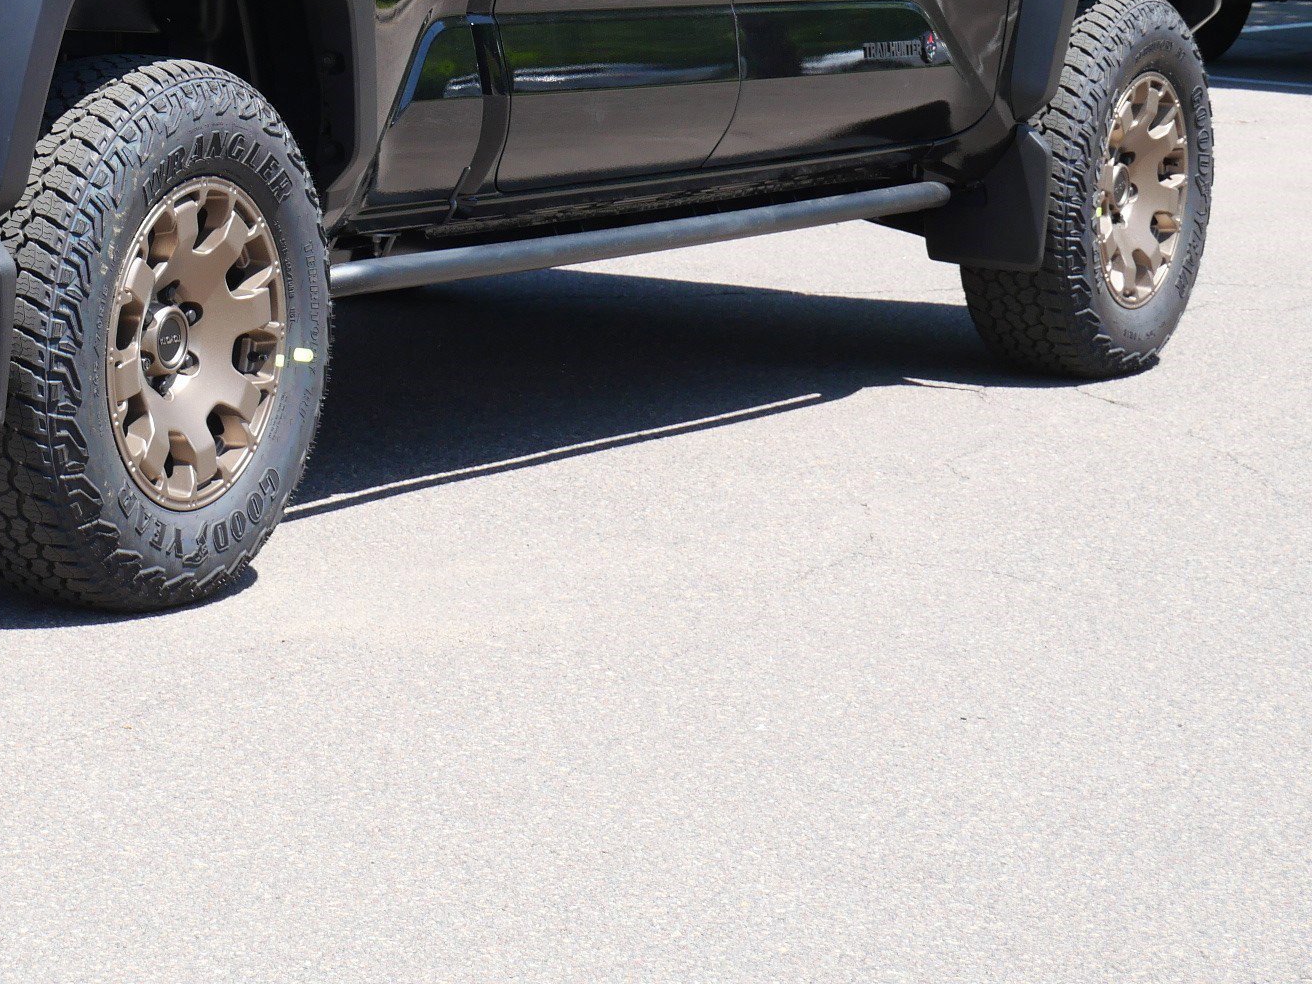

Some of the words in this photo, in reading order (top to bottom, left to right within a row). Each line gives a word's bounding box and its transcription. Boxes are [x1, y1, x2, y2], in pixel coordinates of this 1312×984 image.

[863, 39, 923, 59] TRAILHUNTER
[142, 129, 293, 206] WRANGLER
[117, 467, 280, 567] GOODYEAR
